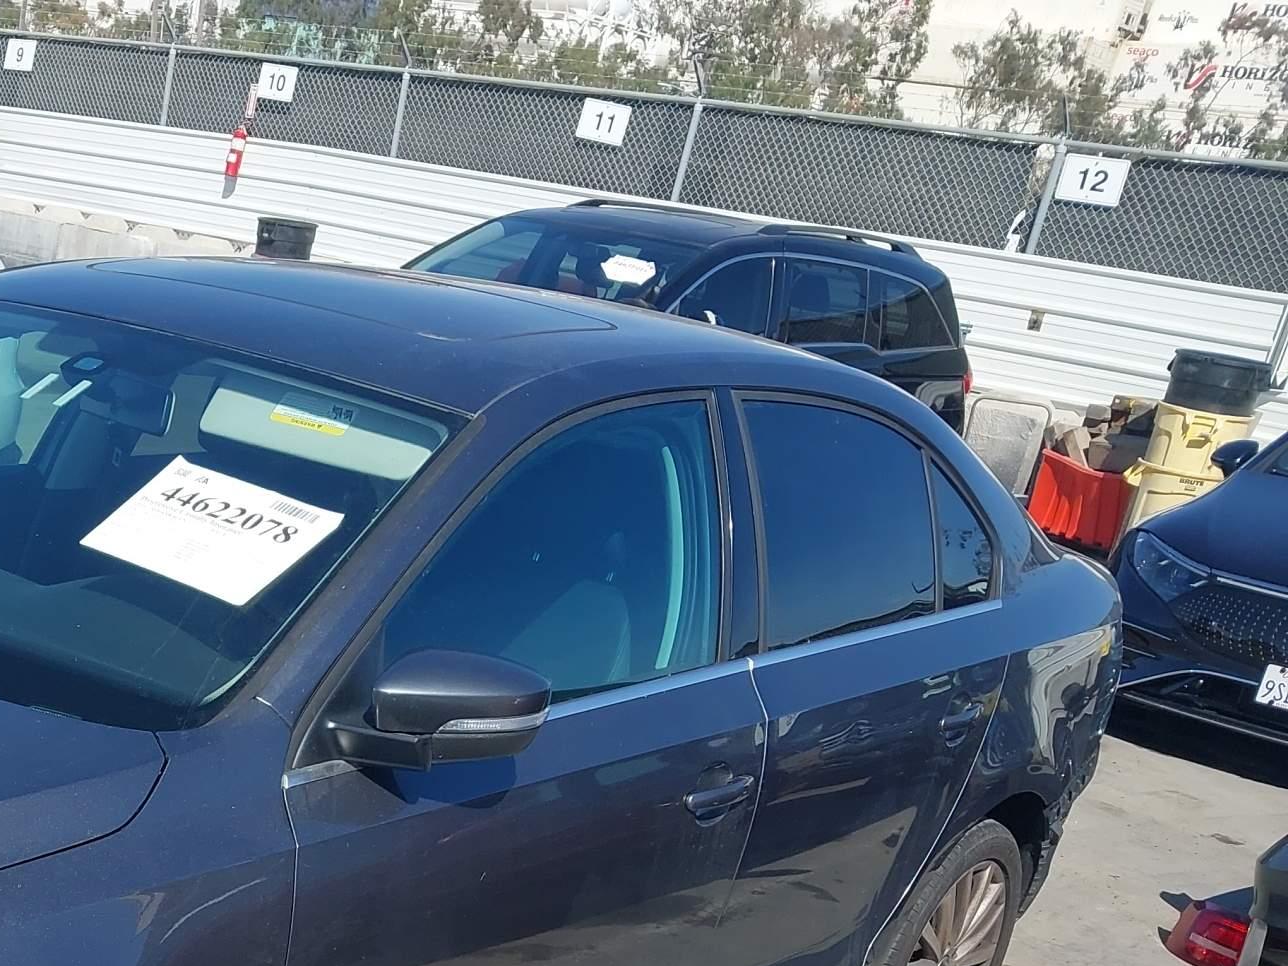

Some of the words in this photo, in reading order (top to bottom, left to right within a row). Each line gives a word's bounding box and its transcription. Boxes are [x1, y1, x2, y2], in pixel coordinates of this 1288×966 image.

[16, 47, 24, 62] 9
[1127, 47, 1159, 57] seaco
[269, 73, 286, 92] 10
[596, 111, 615, 133] 11
[1079, 167, 1109, 193] 12
[1178, 477, 1204, 487] BRUTE
[160, 486, 299, 543] 44622078
